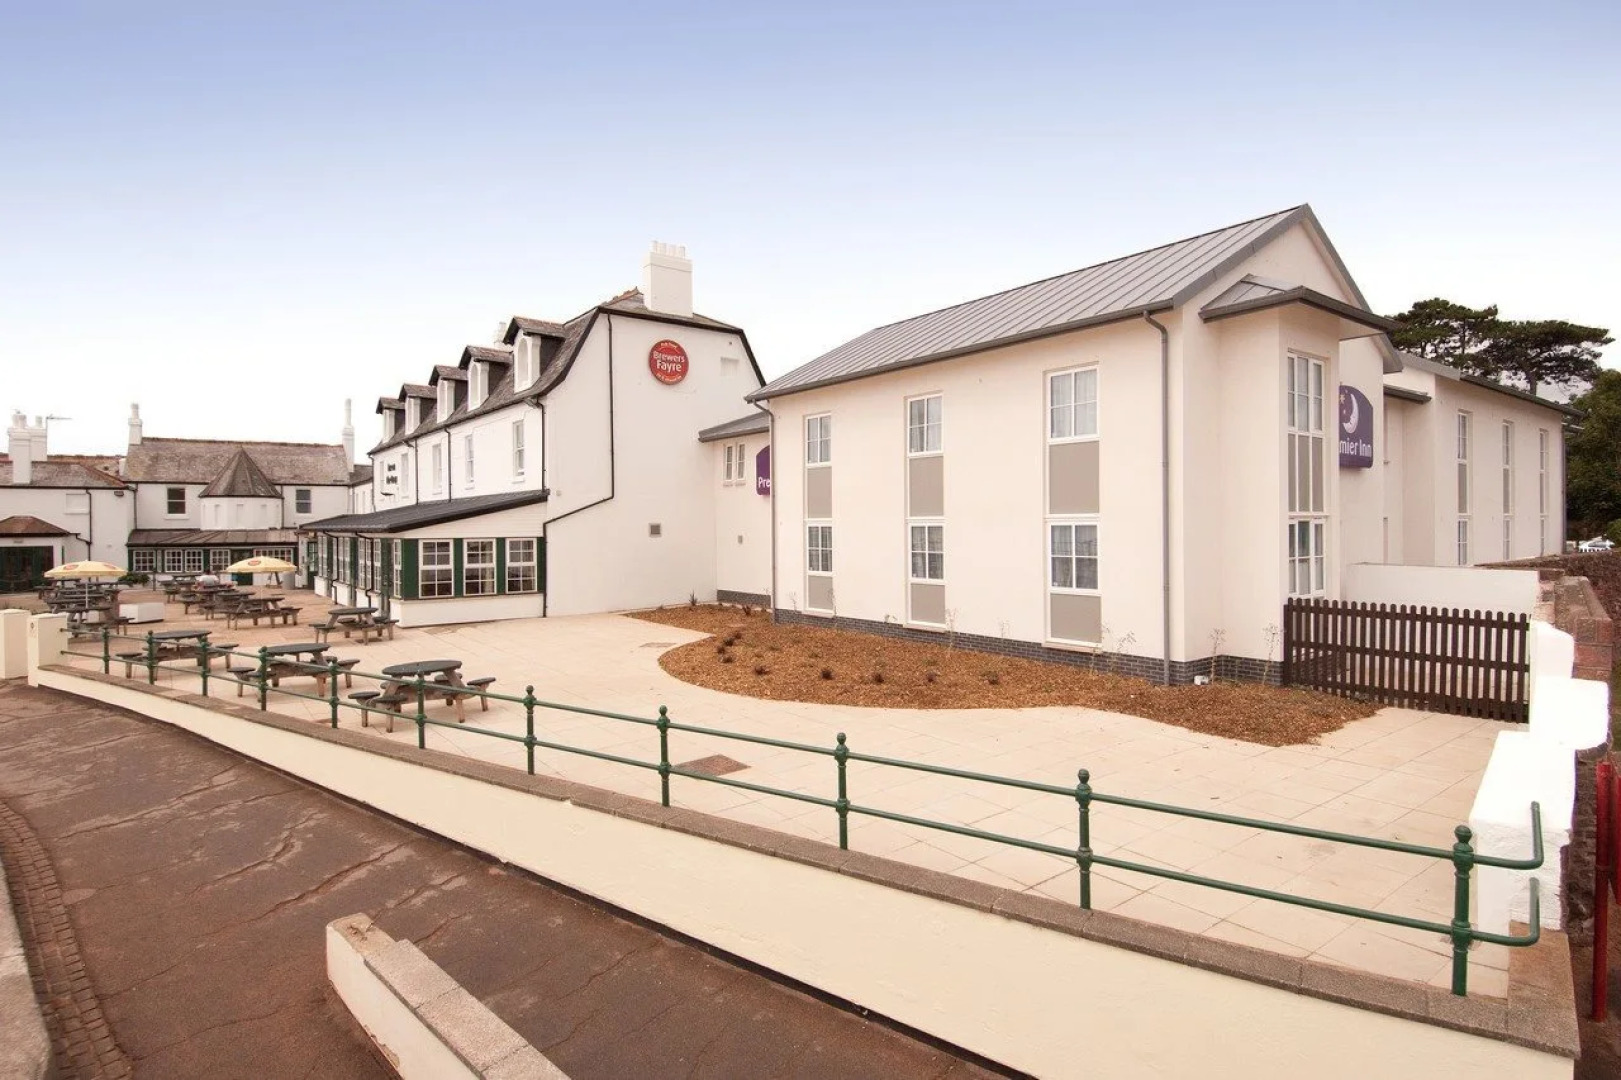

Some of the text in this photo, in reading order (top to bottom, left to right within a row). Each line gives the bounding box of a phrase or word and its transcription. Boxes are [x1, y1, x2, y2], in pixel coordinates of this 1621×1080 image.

[653, 351, 685, 362] Brewers
[656, 360, 682, 373] Fayre
[1339, 437, 1372, 458] mier Inn
[758, 476, 771, 488] Pre
